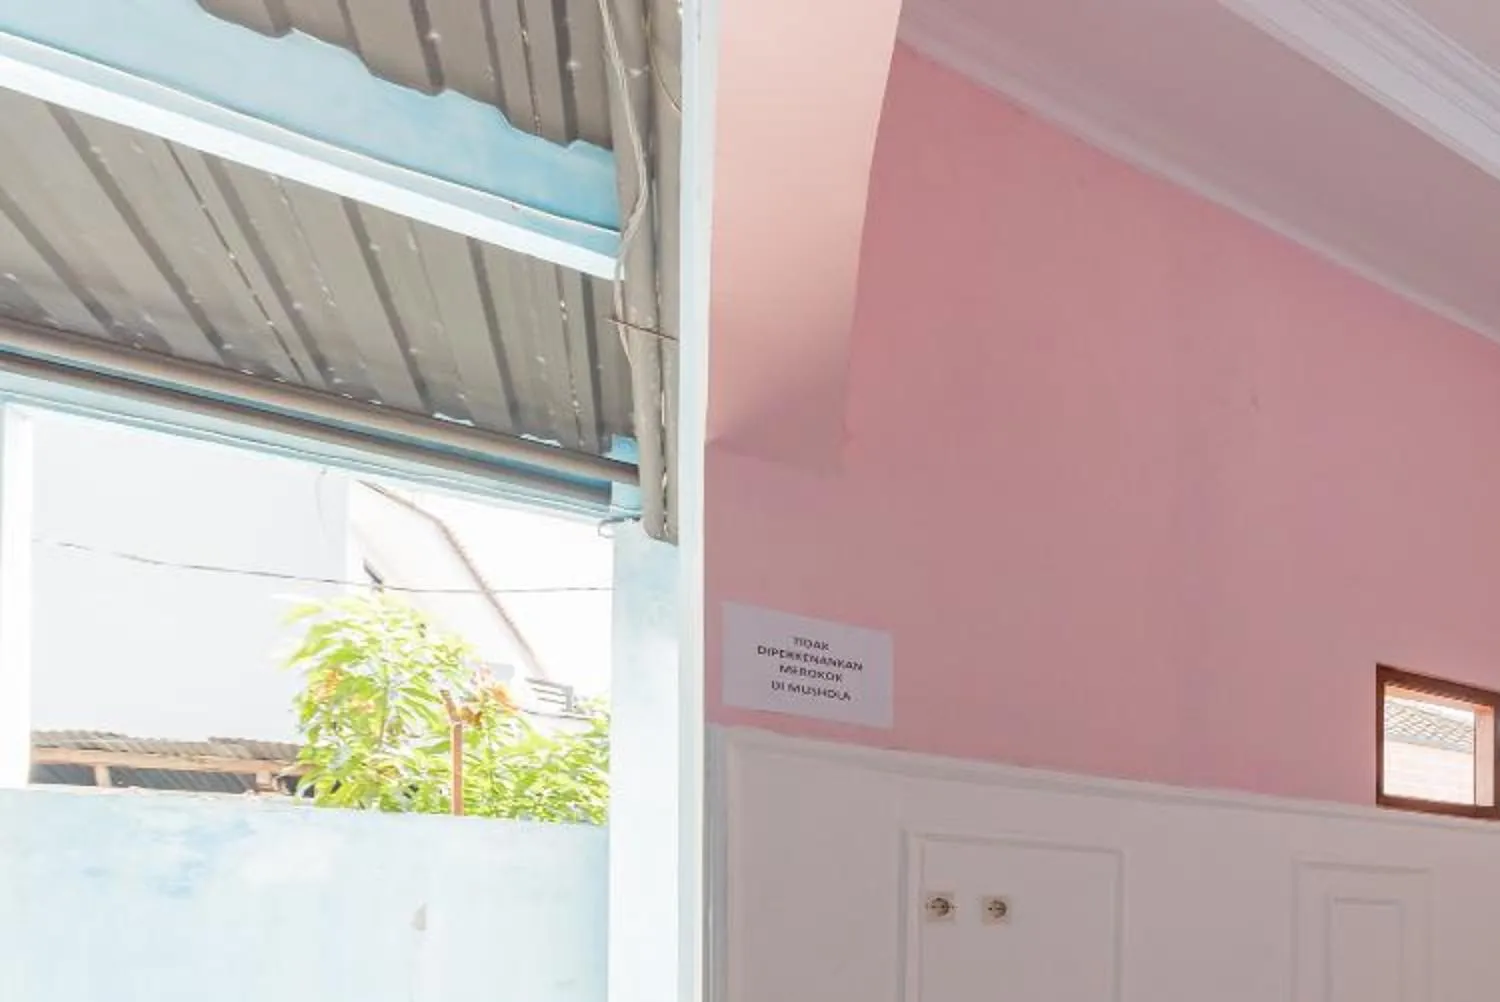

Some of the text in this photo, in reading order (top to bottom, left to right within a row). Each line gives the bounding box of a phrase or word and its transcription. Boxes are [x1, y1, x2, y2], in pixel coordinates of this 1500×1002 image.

[793, 637, 830, 651] TIDAK
[757, 645, 863, 671] DIPERKENANKAN
[779, 665, 843, 682] MEROKOK
[771, 680, 851, 701] DI MUSHOLA
